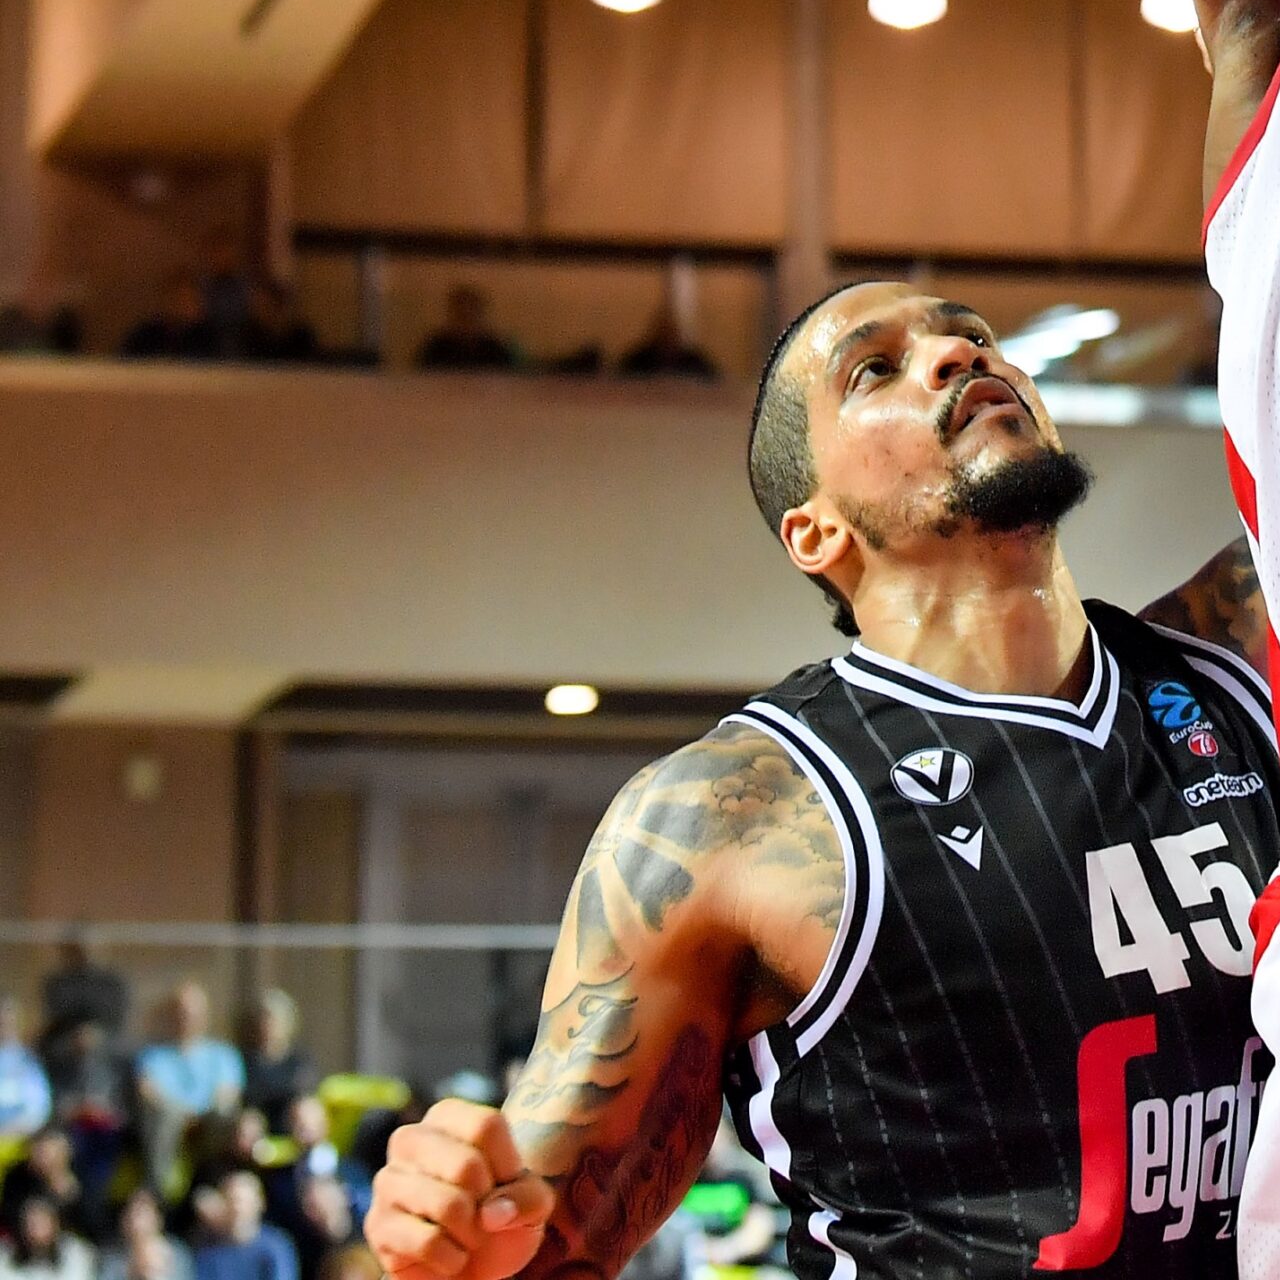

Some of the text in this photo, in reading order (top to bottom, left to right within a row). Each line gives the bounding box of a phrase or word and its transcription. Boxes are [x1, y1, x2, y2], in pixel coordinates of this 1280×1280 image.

[1168, 720, 1214, 745] EuroCup
[1184, 772, 1263, 807] oneteam
[1085, 821, 1258, 995] 45
[1032, 1014, 1267, 1271] Segaf
